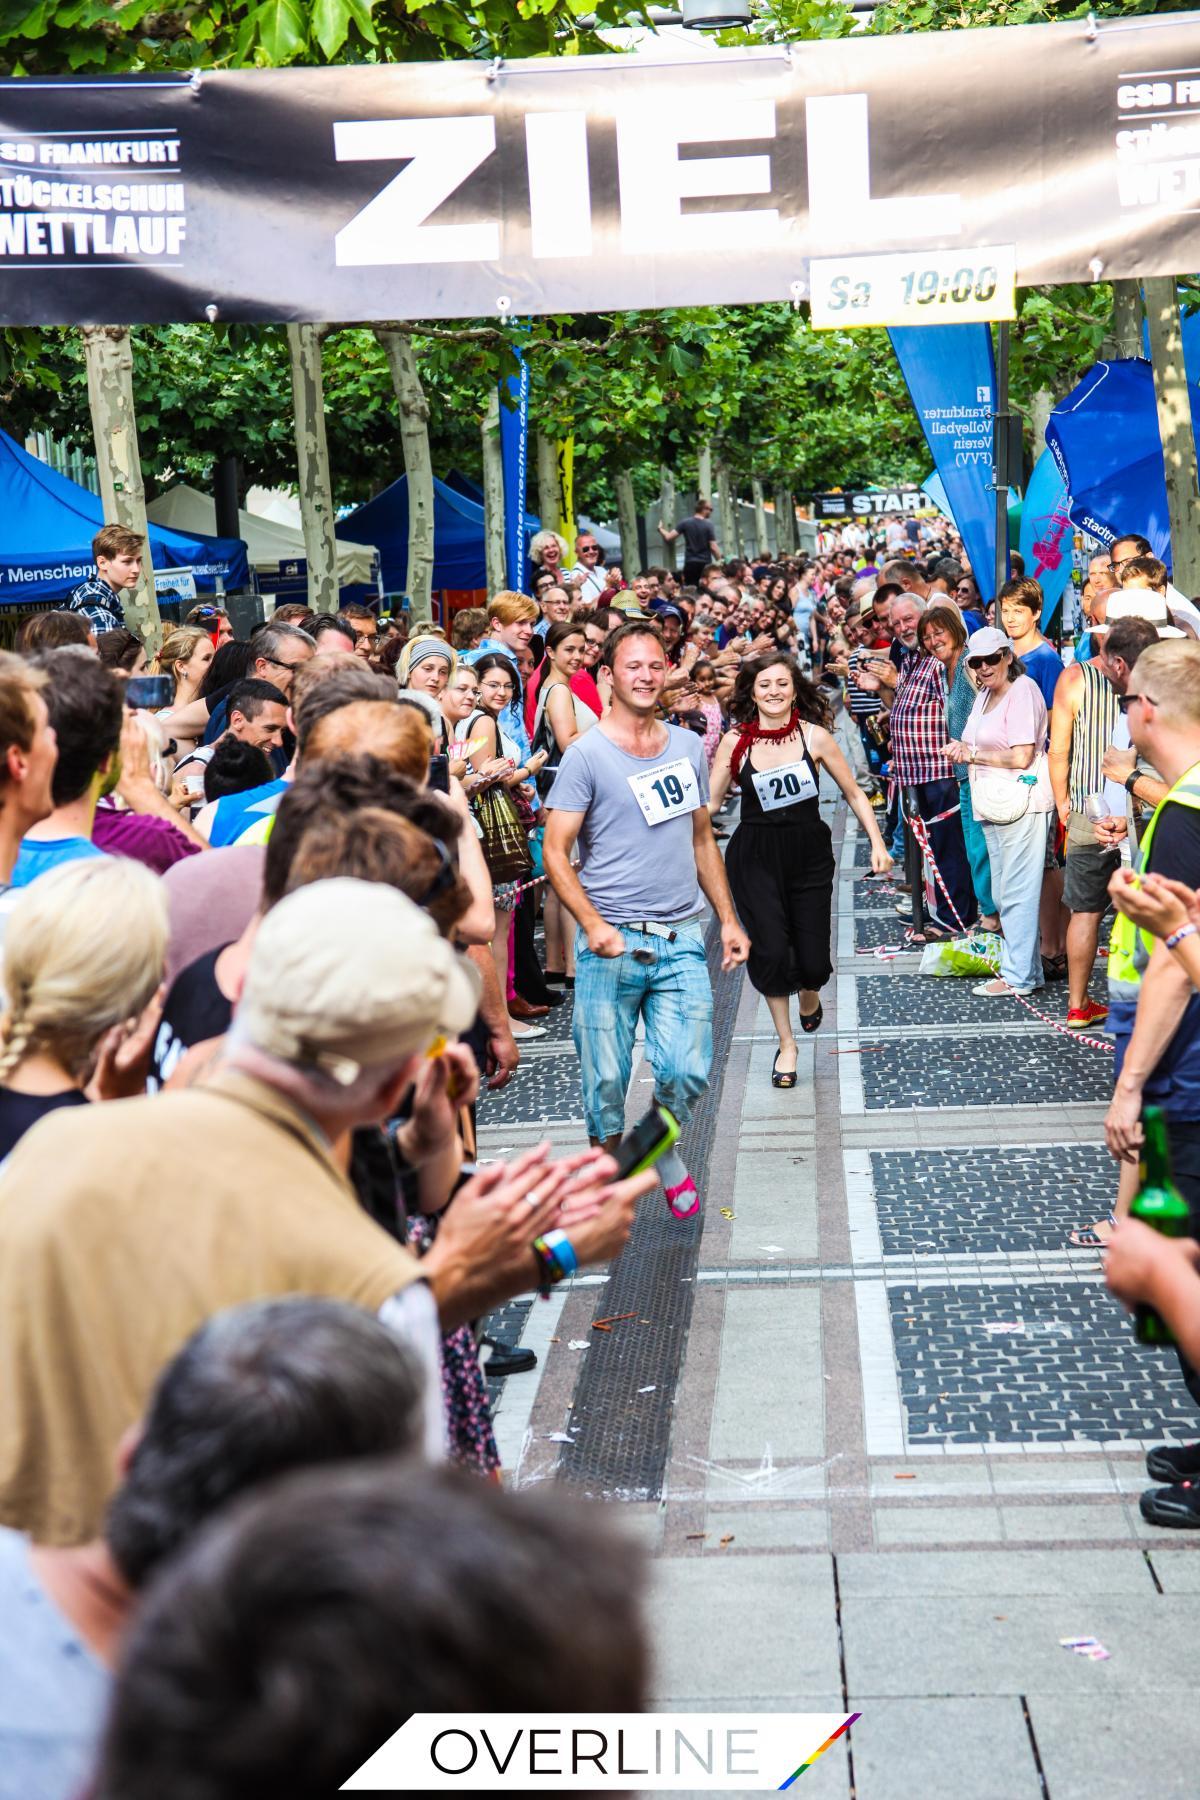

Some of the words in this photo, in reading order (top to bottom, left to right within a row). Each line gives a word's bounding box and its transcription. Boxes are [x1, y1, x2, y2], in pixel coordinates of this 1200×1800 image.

[1117, 82, 1172, 109] CSD
[39, 140, 181, 164] FRANKFURT
[0, 175, 185, 211] TÖCKELSCHUH
[333, 92, 962, 267] ZIEL
[827, 275, 872, 311] Sa
[900, 266, 998, 305] 19:00
[651, 774, 684, 809] 19
[769, 773, 801, 801] 20
